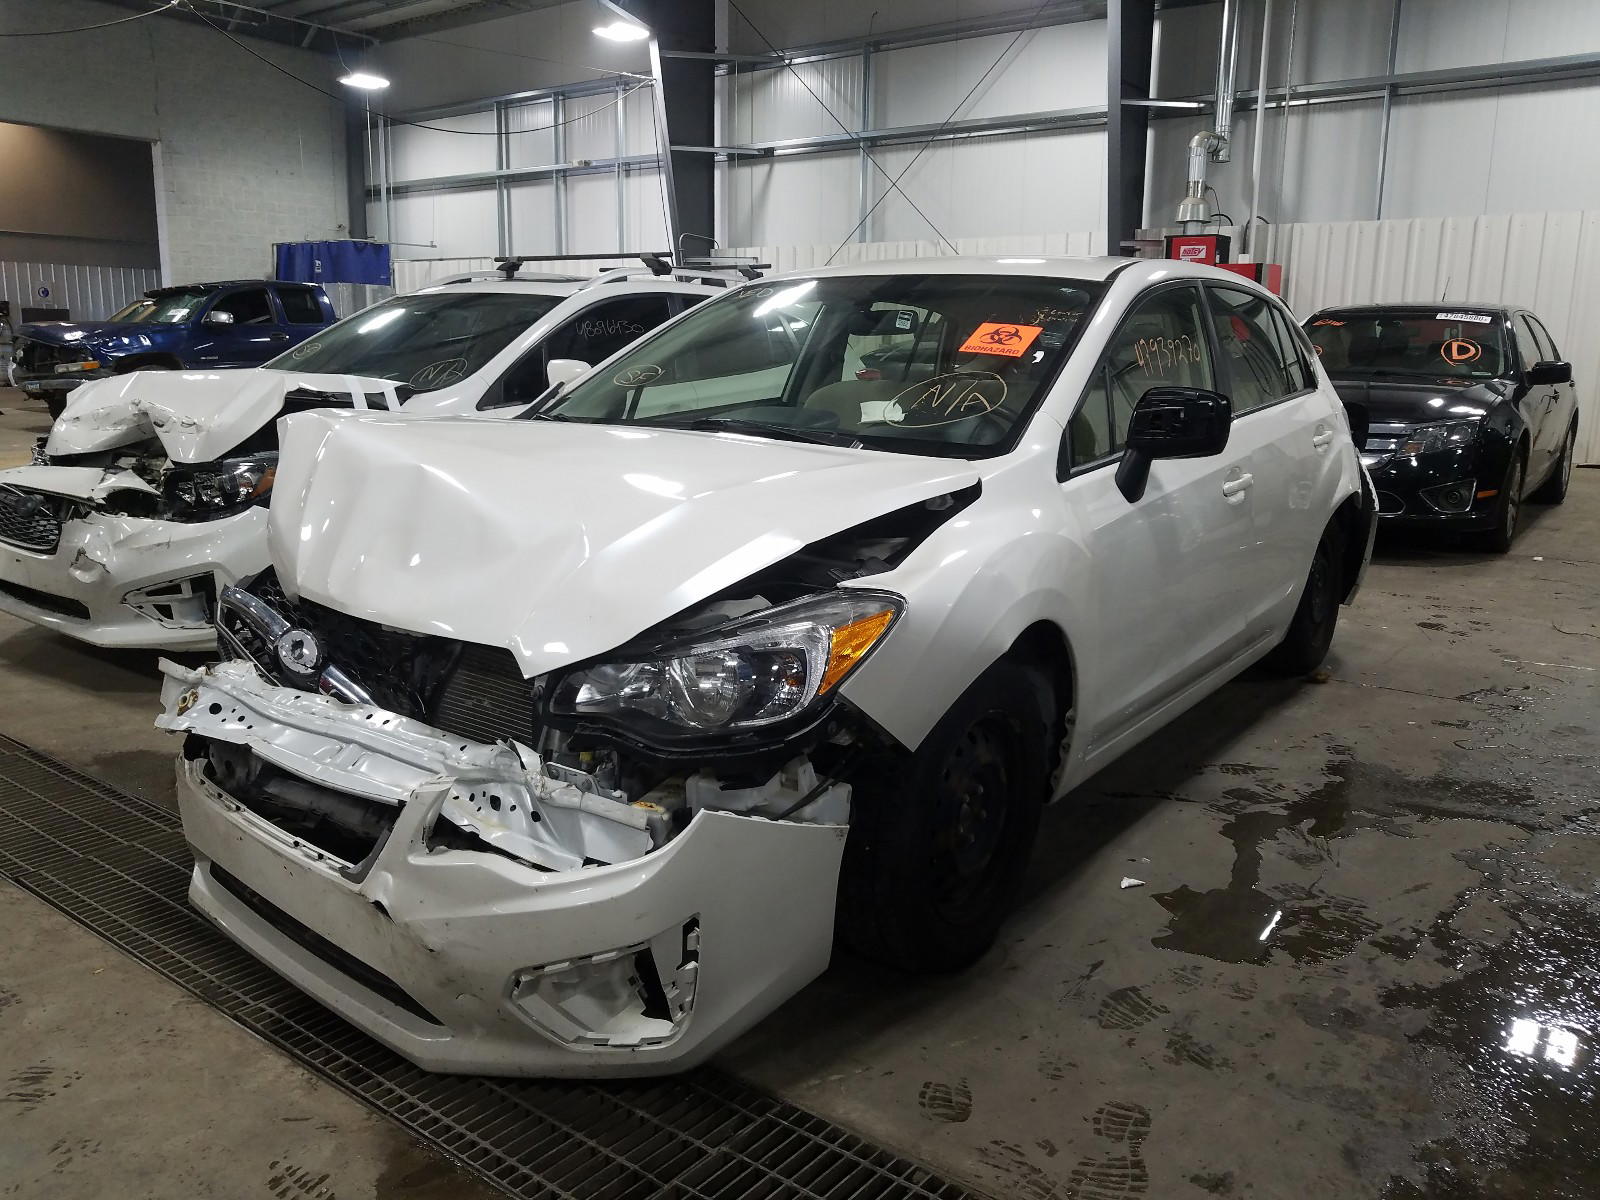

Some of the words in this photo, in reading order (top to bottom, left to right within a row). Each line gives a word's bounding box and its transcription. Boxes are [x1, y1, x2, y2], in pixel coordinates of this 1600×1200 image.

[963, 345, 1020, 355] BIOHAZARD
[1451, 341, 1476, 360] D
[910, 380, 991, 416] N/A
